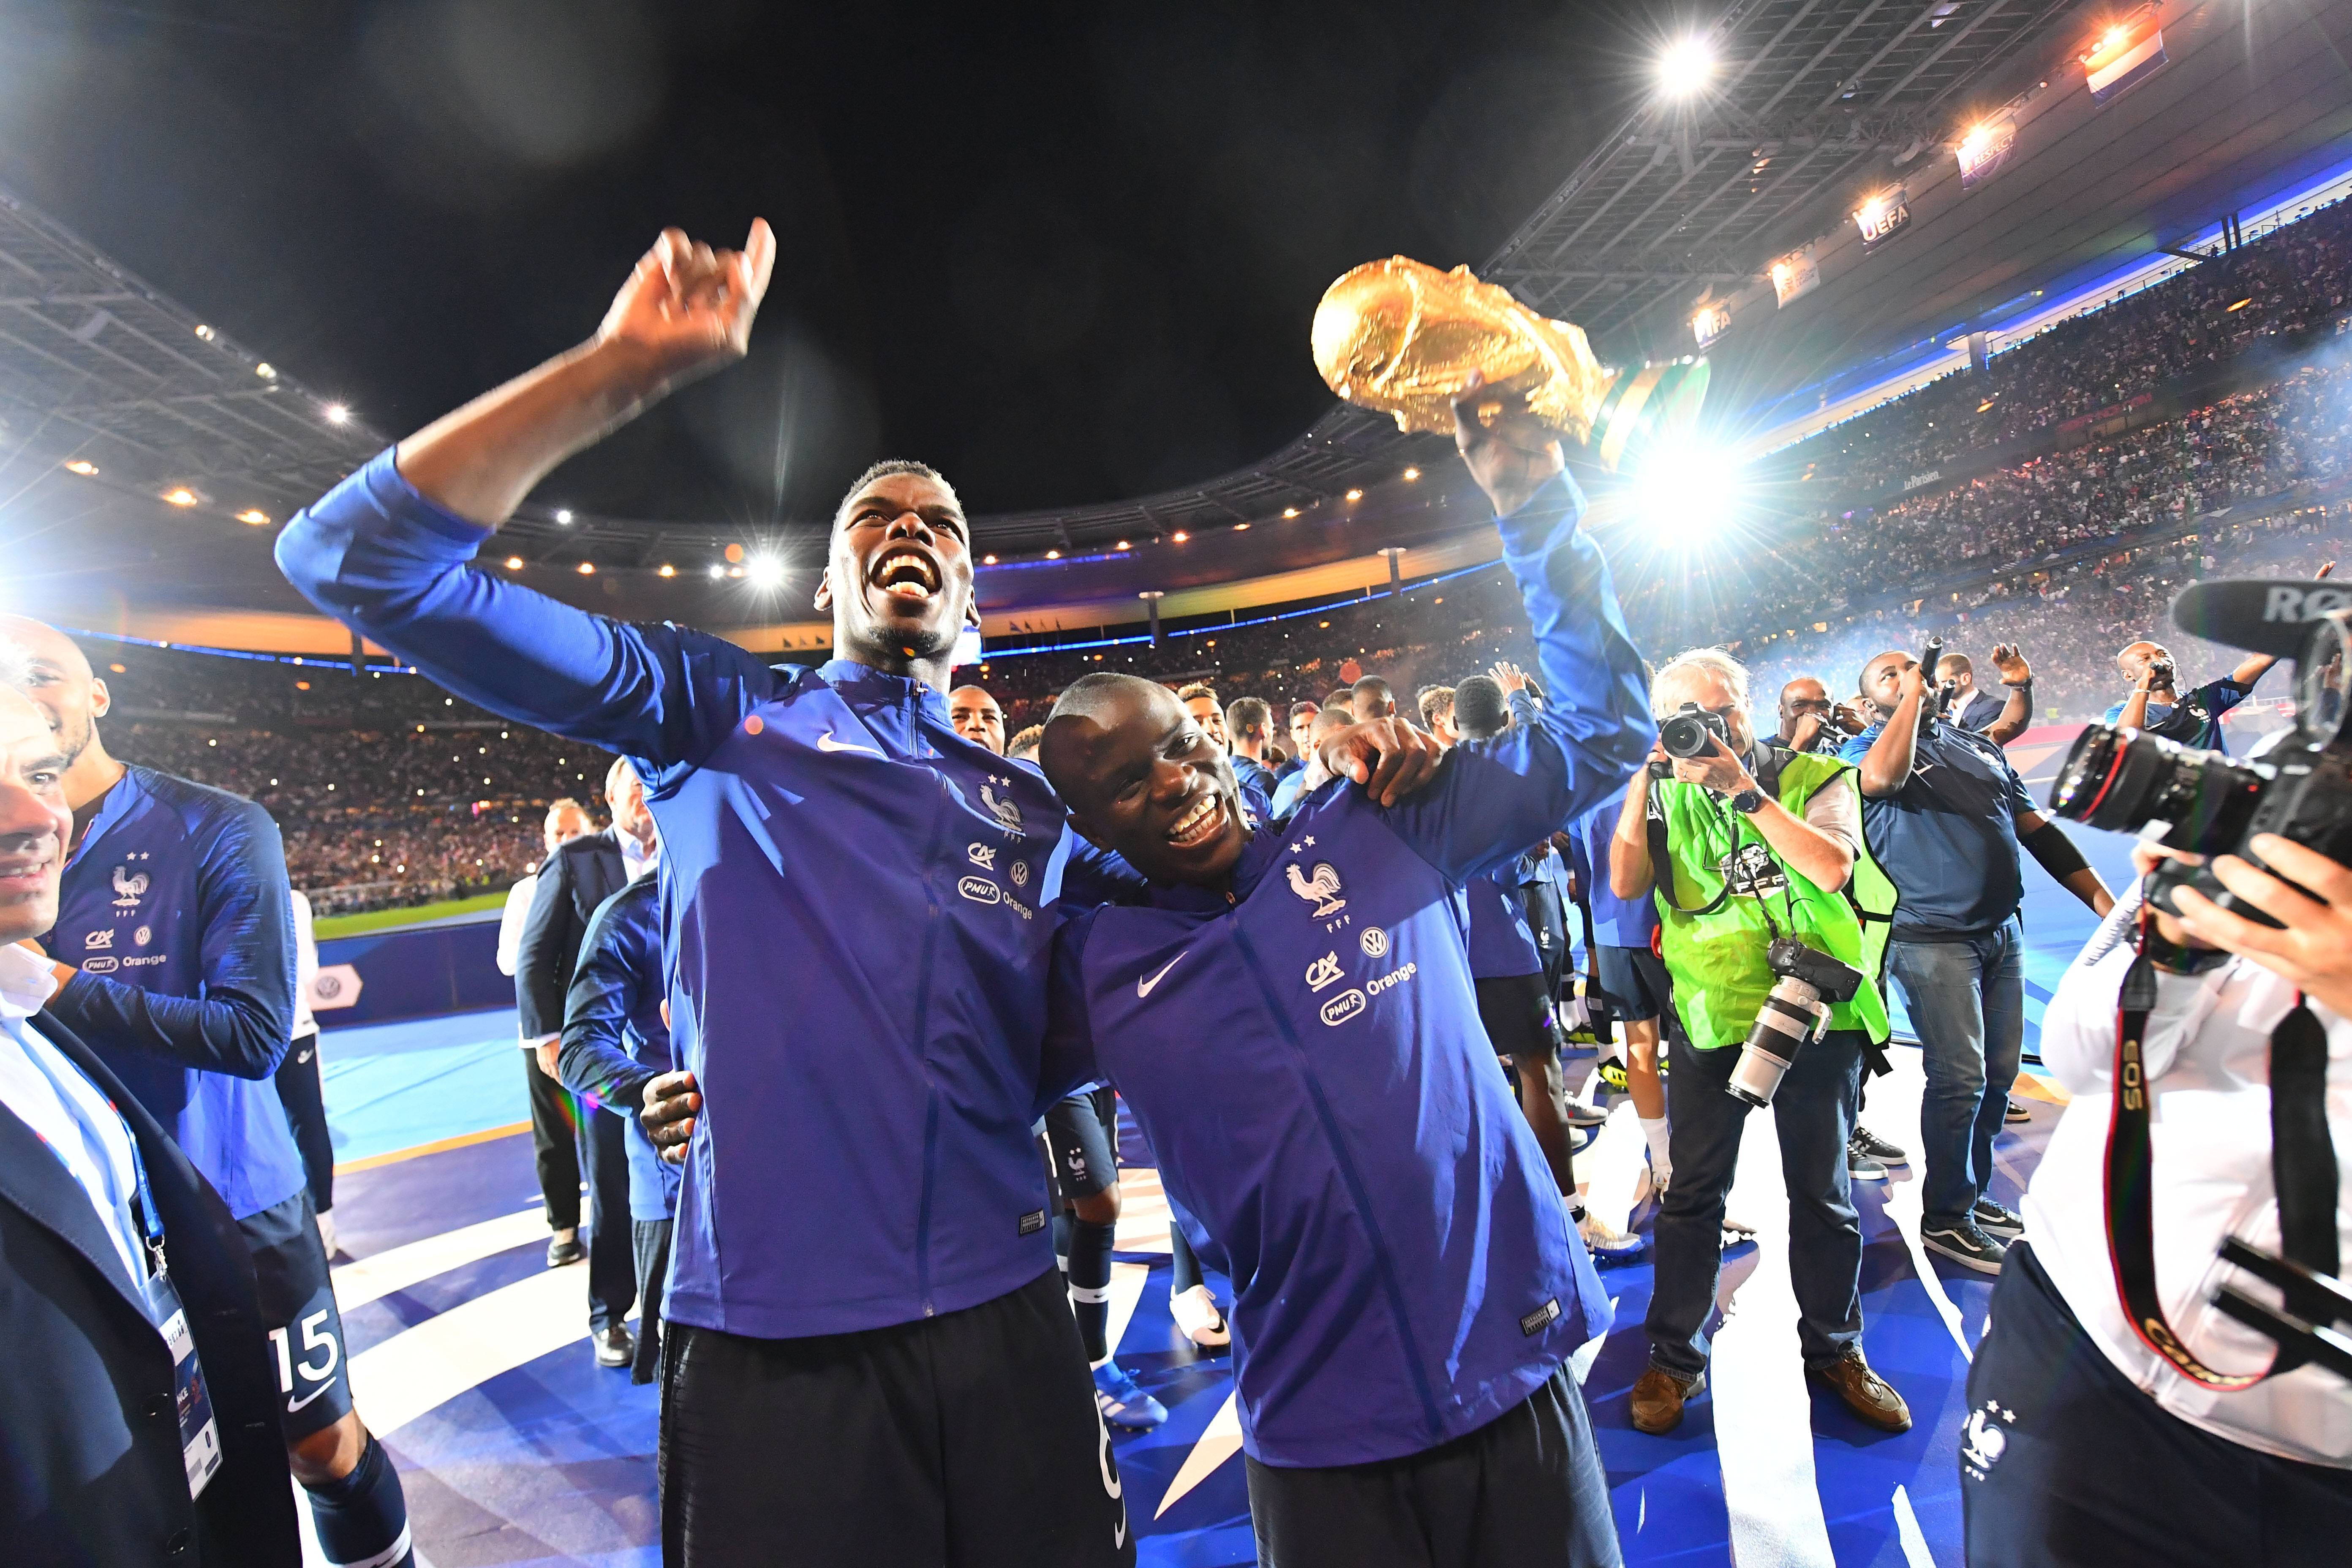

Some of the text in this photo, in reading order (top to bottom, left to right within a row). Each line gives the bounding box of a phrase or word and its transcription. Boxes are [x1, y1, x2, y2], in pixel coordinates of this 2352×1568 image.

[1974, 135, 2013, 166] RESPECT
[1862, 206, 1908, 241] UEFA
[964, 881, 989, 895] PMU
[1003, 891, 1032, 920] Orange
[122, 955, 166, 967] Orange
[1367, 963, 1417, 995] Orange
[1327, 998, 1350, 1019] PMU
[2123, 1039, 2143, 1111] EOS
[268, 1309, 338, 1393] 15
